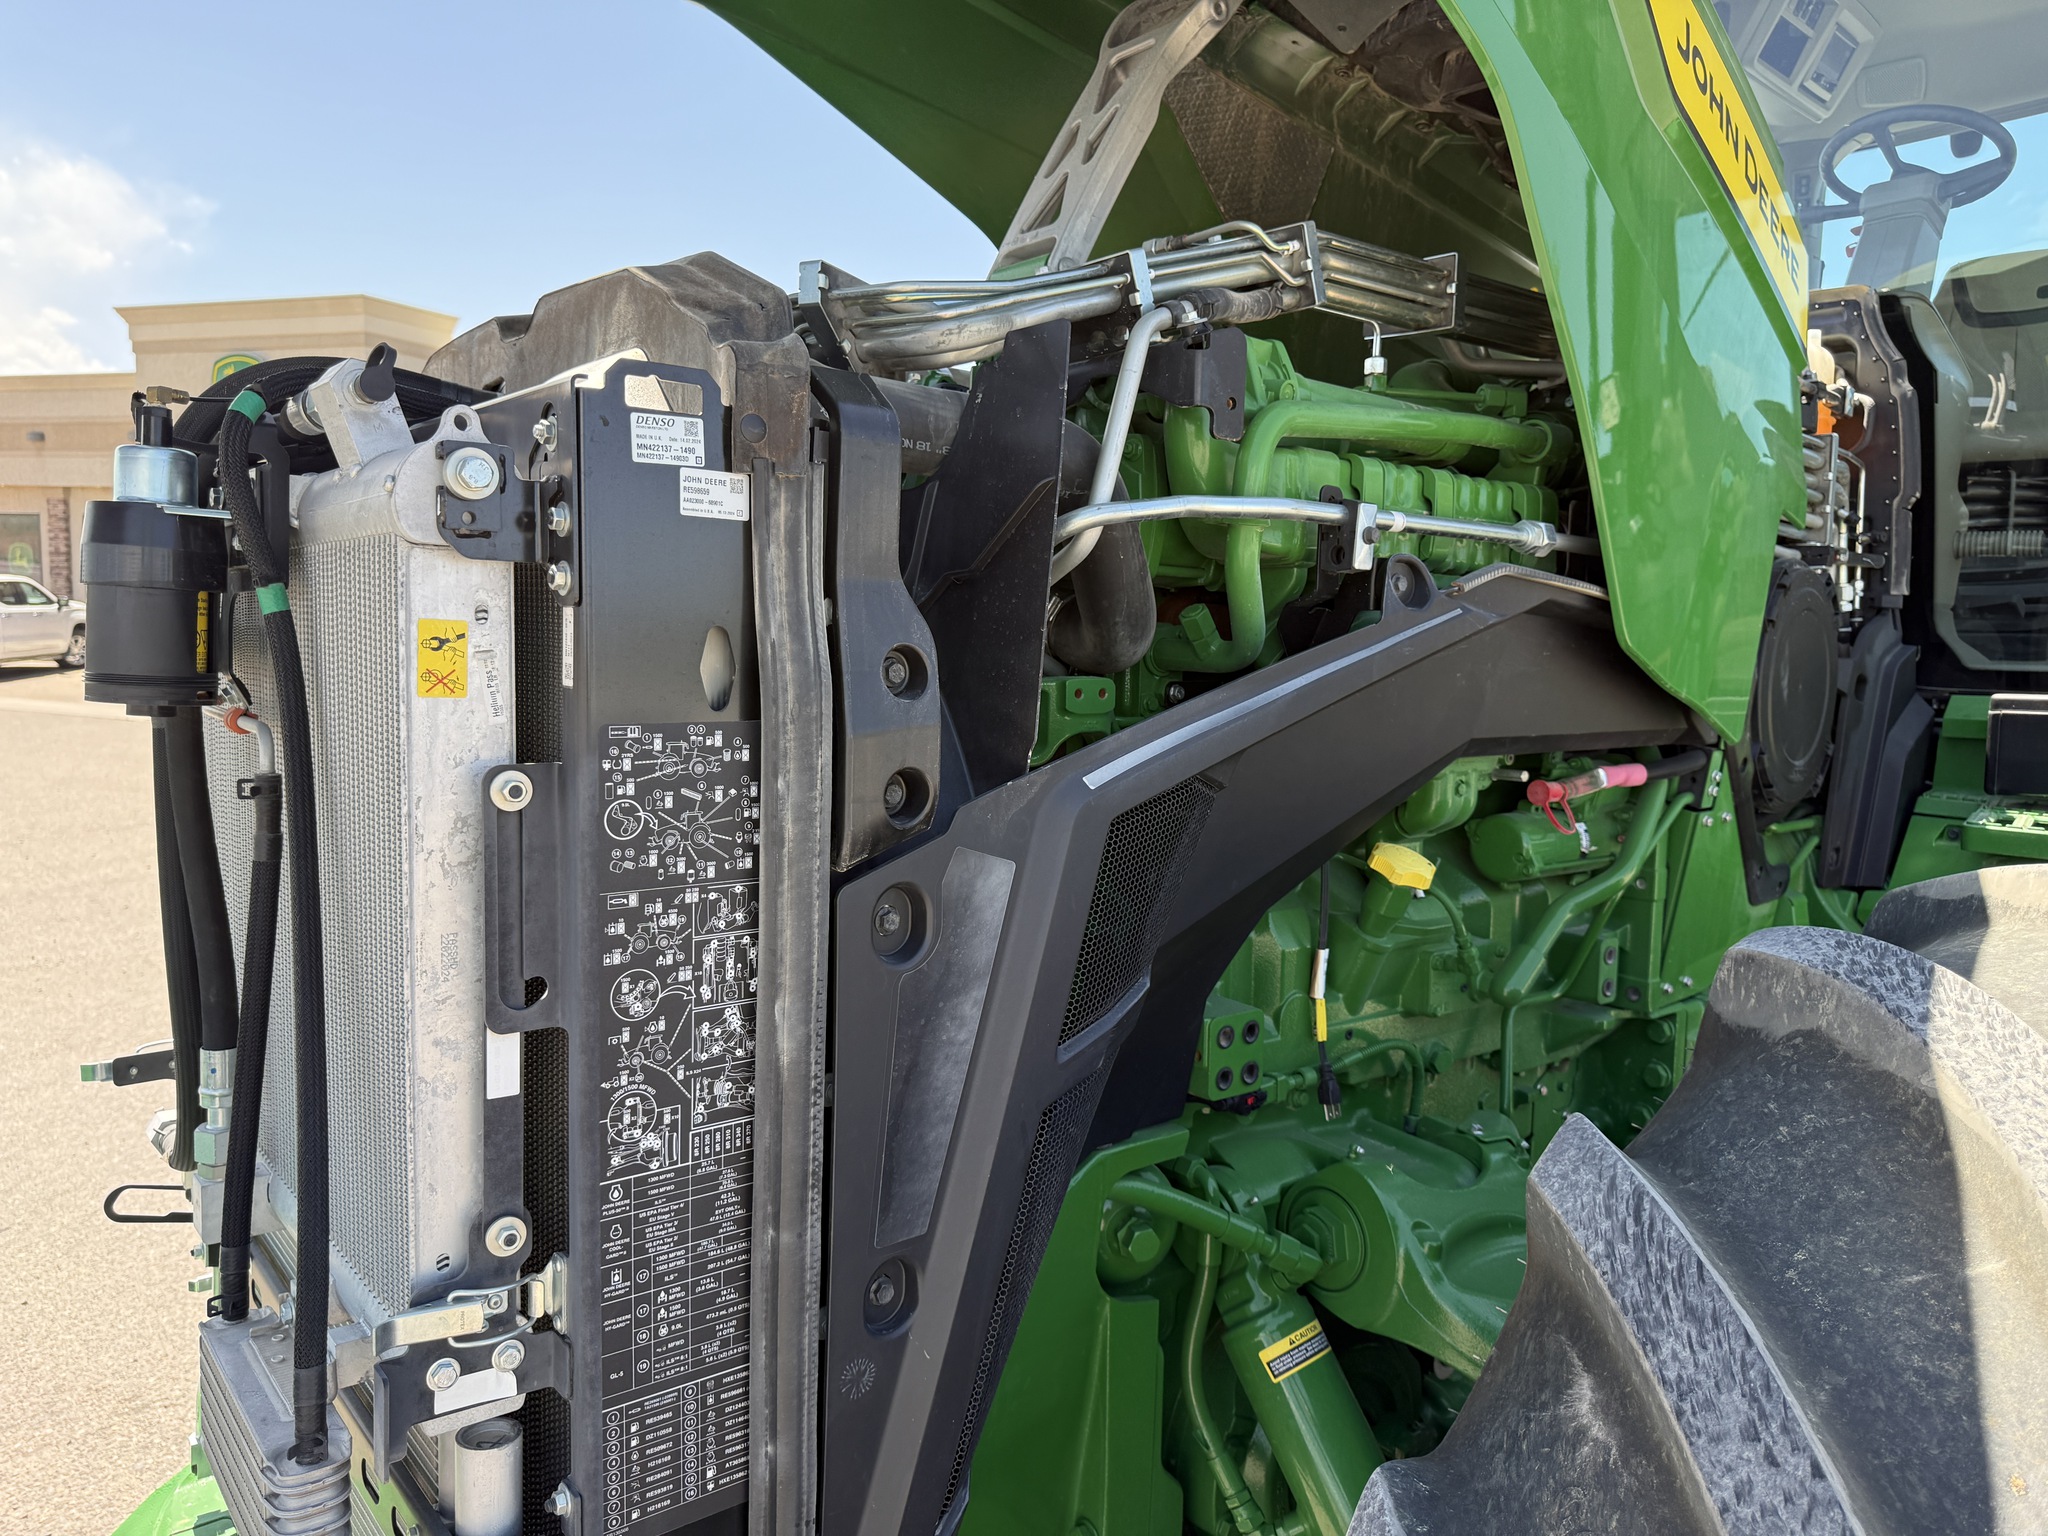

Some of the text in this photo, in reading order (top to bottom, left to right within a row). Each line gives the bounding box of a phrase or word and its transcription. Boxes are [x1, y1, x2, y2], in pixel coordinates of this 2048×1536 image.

[1677, 17, 1799, 294] JOHN DEERE
[636, 415, 675, 427] DENSO
[916, 440, 931, 451] 18
[683, 475, 727, 487] JOHN DEERE
[486, 670, 494, 688] Pass
[490, 691, 500, 717] Helium
[450, 932, 459, 970] PASSHD
[610, 1083, 656, 1101] 1300/1500 MFWD
[659, 1172, 675, 1180] MFWD
[659, 1184, 675, 1192] MFWD
[727, 1195, 741, 1203] GAL)
[602, 1202, 614, 1210] JOHN
[615, 1237, 630, 1245] DEERE
[656, 1249, 685, 1262] 1300 MFWD
[668, 1259, 685, 1268] MFWD
[707, 1253, 750, 1270] 207.2 (54.7 GAL)
[602, 1285, 615, 1293] JOHN
[705, 1281, 719, 1289] GAL)
[668, 1291, 686, 1300] MFWD
[726, 1292, 739, 1300] GAL)
[669, 1303, 681, 1311] 1500
[669, 1308, 686, 1317] MFWD
[706, 1311, 719, 1319] 473.2
[616, 1314, 631, 1322] DEERE
[667, 1339, 685, 1348] MFWD
[609, 1370, 624, 1379] GL-5
[687, 1403, 695, 1411] 10
[687, 1461, 694, 1469] 14
